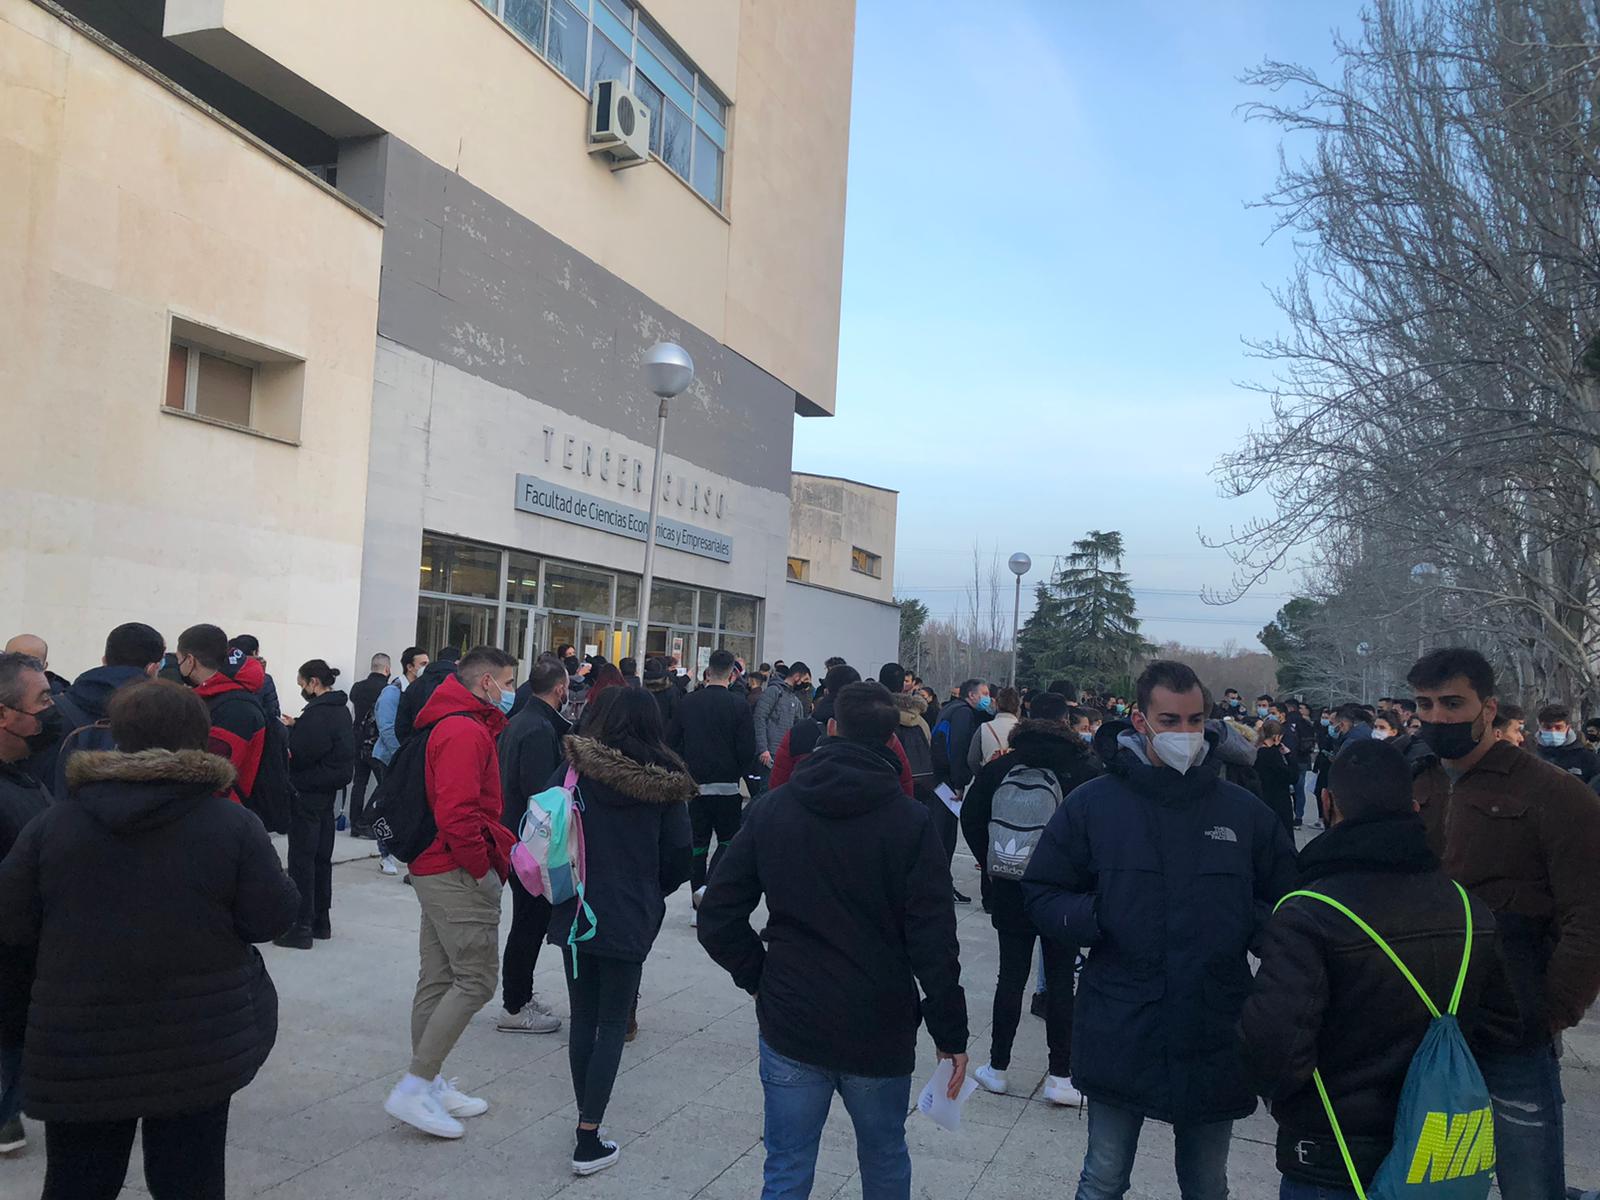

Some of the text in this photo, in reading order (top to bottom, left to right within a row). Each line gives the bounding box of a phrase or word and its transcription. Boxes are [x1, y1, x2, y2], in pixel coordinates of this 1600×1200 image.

[543, 425, 643, 494] TERCER
[525, 483, 729, 556] Facultad de Ciencias Econmicas y Empresariales
[992, 864, 1025, 876] adida
